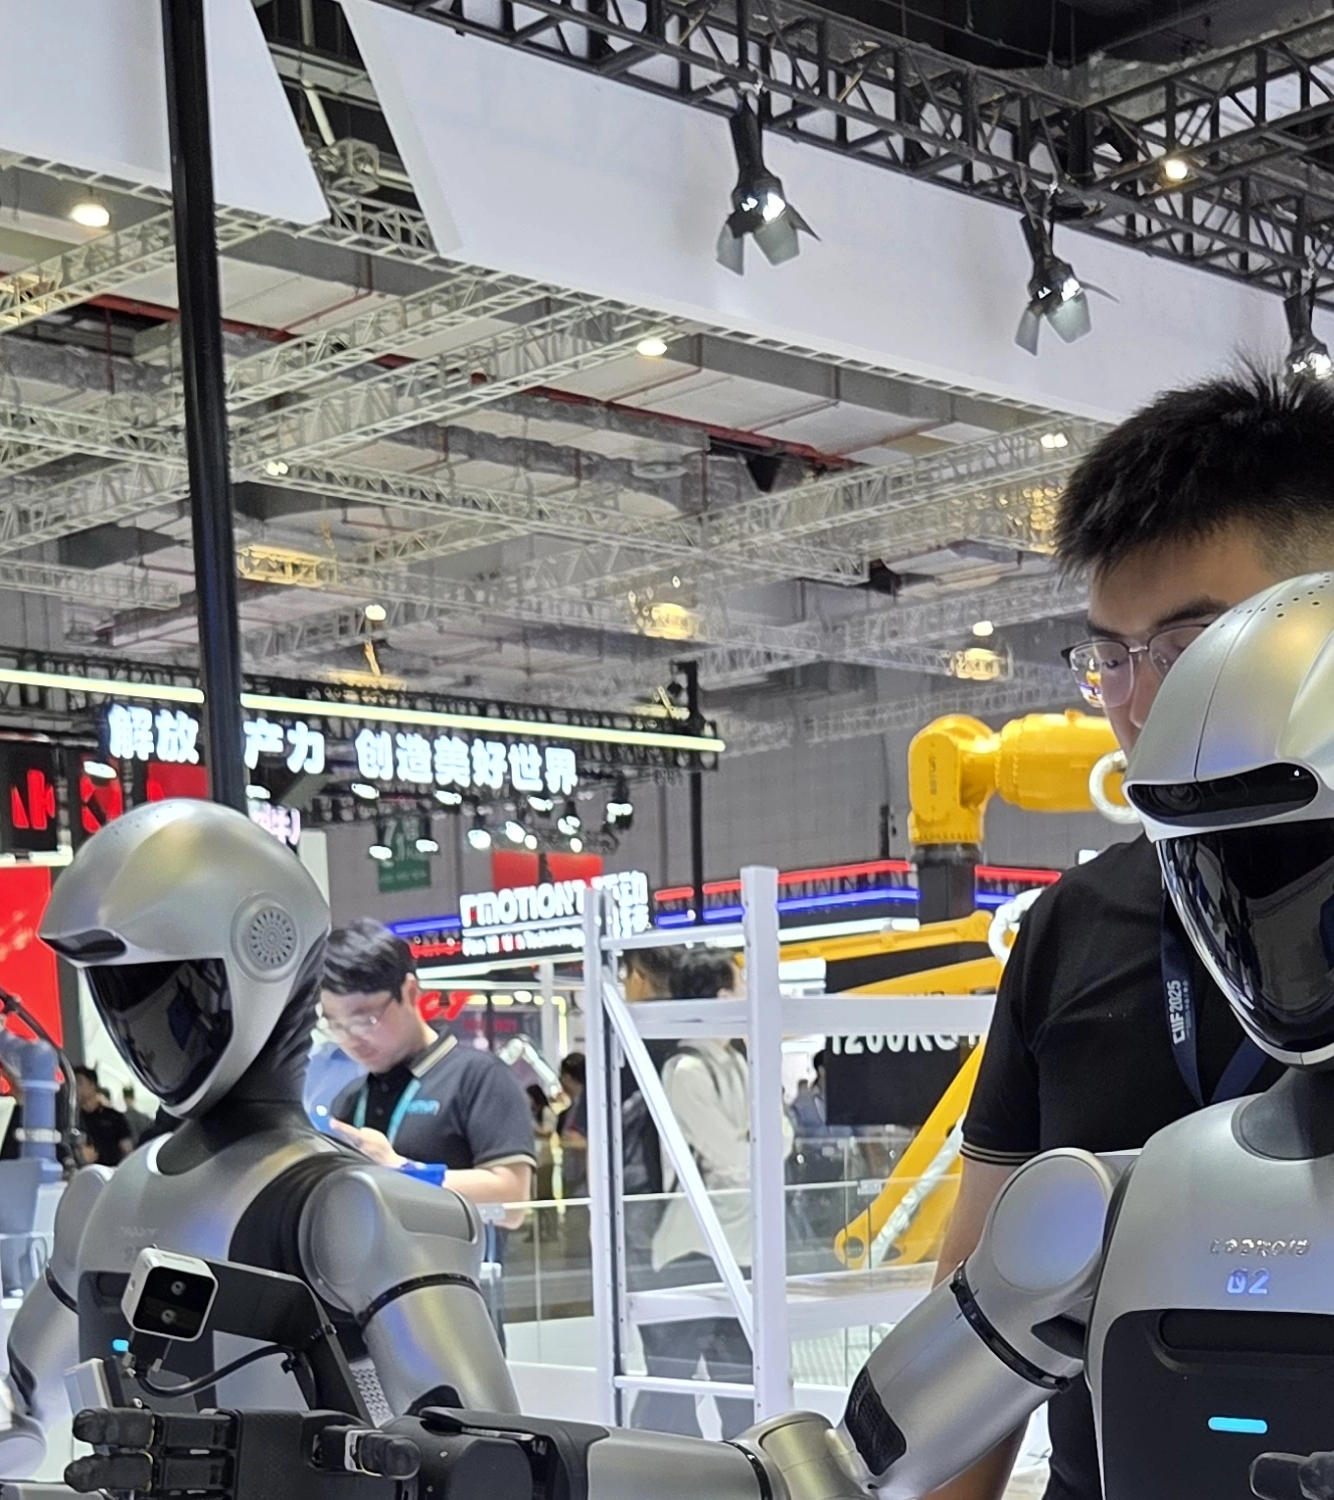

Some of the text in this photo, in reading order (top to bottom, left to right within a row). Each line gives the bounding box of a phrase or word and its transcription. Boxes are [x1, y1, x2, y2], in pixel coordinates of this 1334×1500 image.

[108, 703, 578, 795] 解放产力 创造美好世界
[1167, 980, 1185, 1044] CIIF 2025
